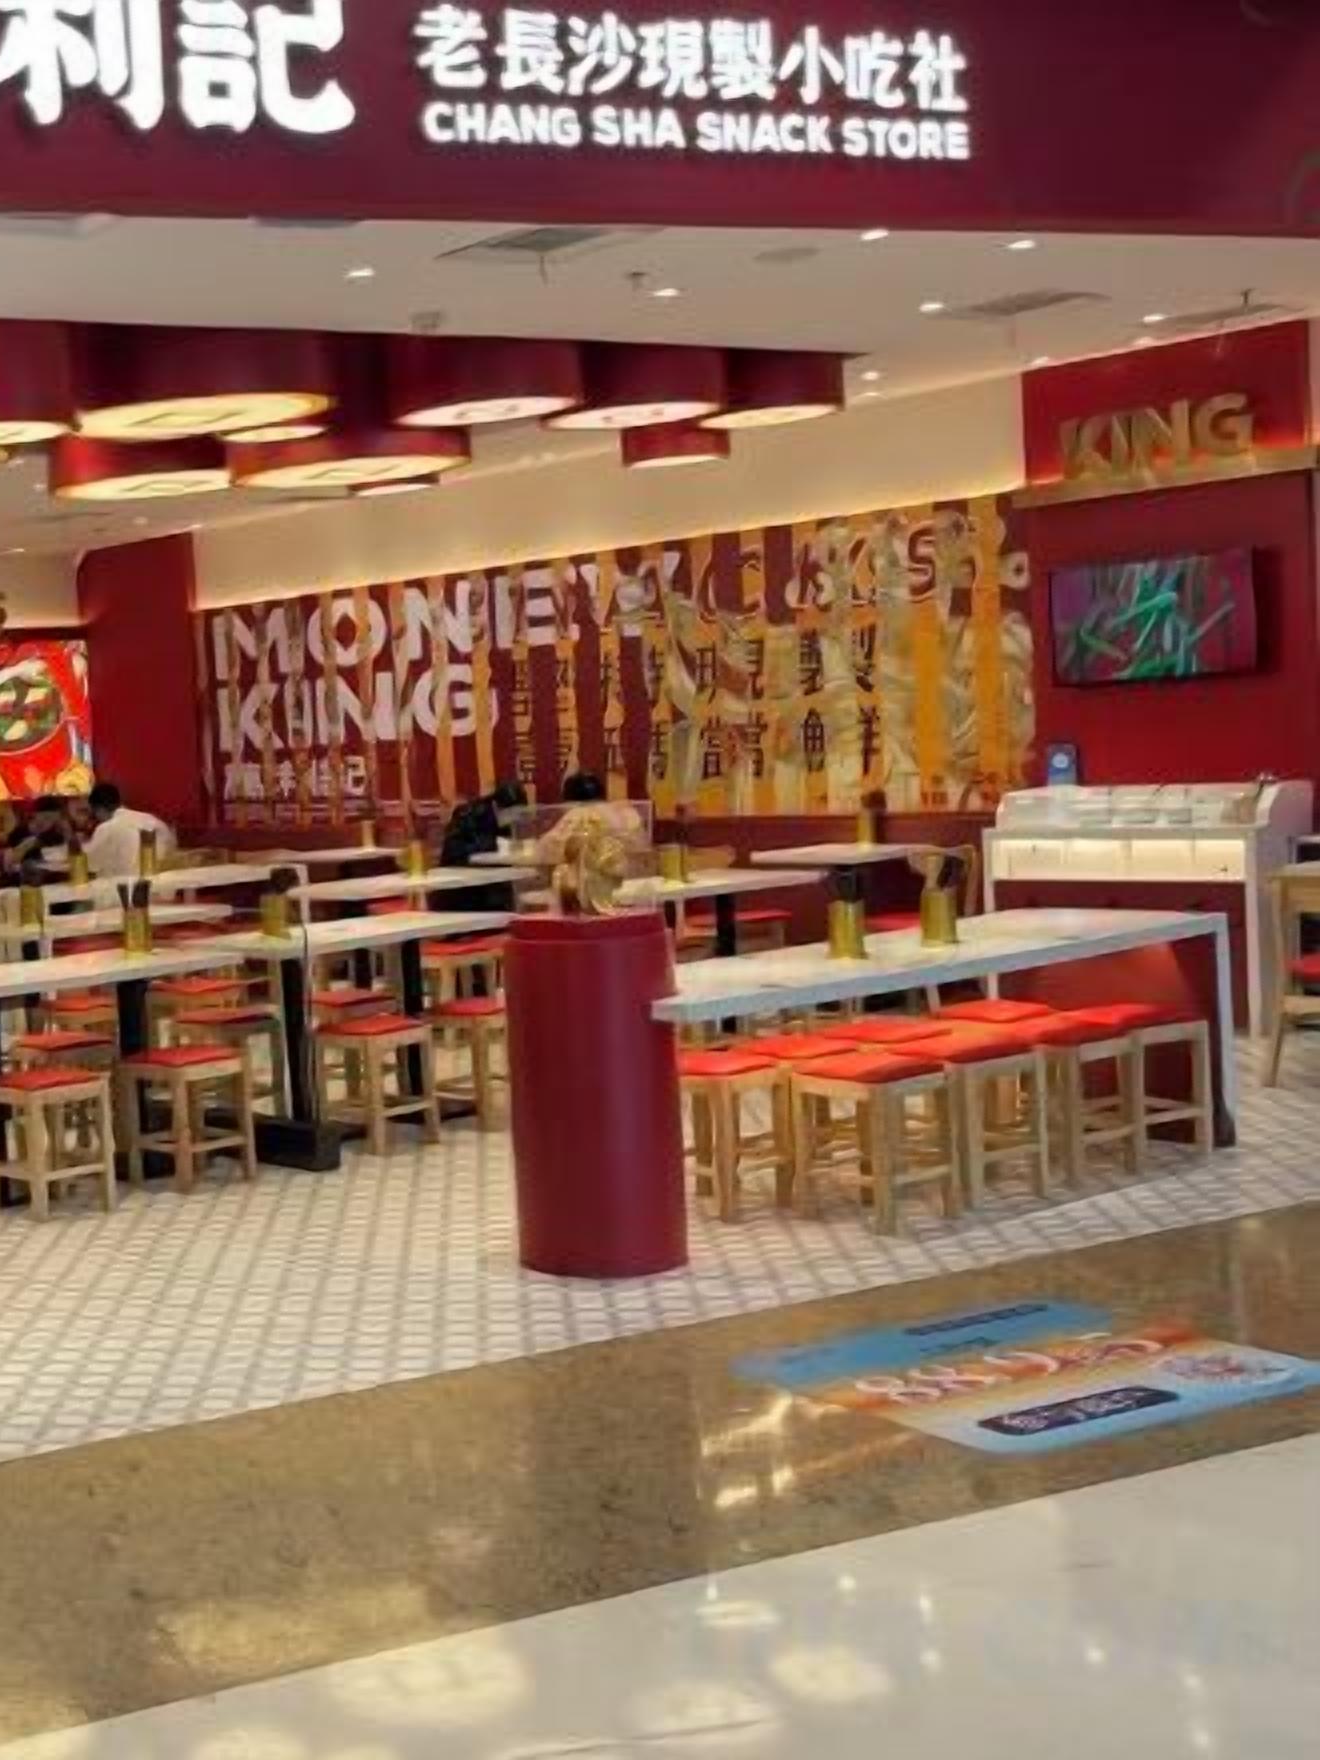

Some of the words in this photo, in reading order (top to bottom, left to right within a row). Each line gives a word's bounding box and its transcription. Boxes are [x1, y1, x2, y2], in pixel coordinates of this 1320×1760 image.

[413, 4, 969, 112] 老長沙現製小吃社
[422, 103, 580, 147] CHANG
[591, 105, 687, 149] SHA
[695, 111, 835, 154] SNACK
[841, 118, 971, 160] STORE
[1058, 393, 1254, 480] KING
[215, 662, 500, 754] KING
